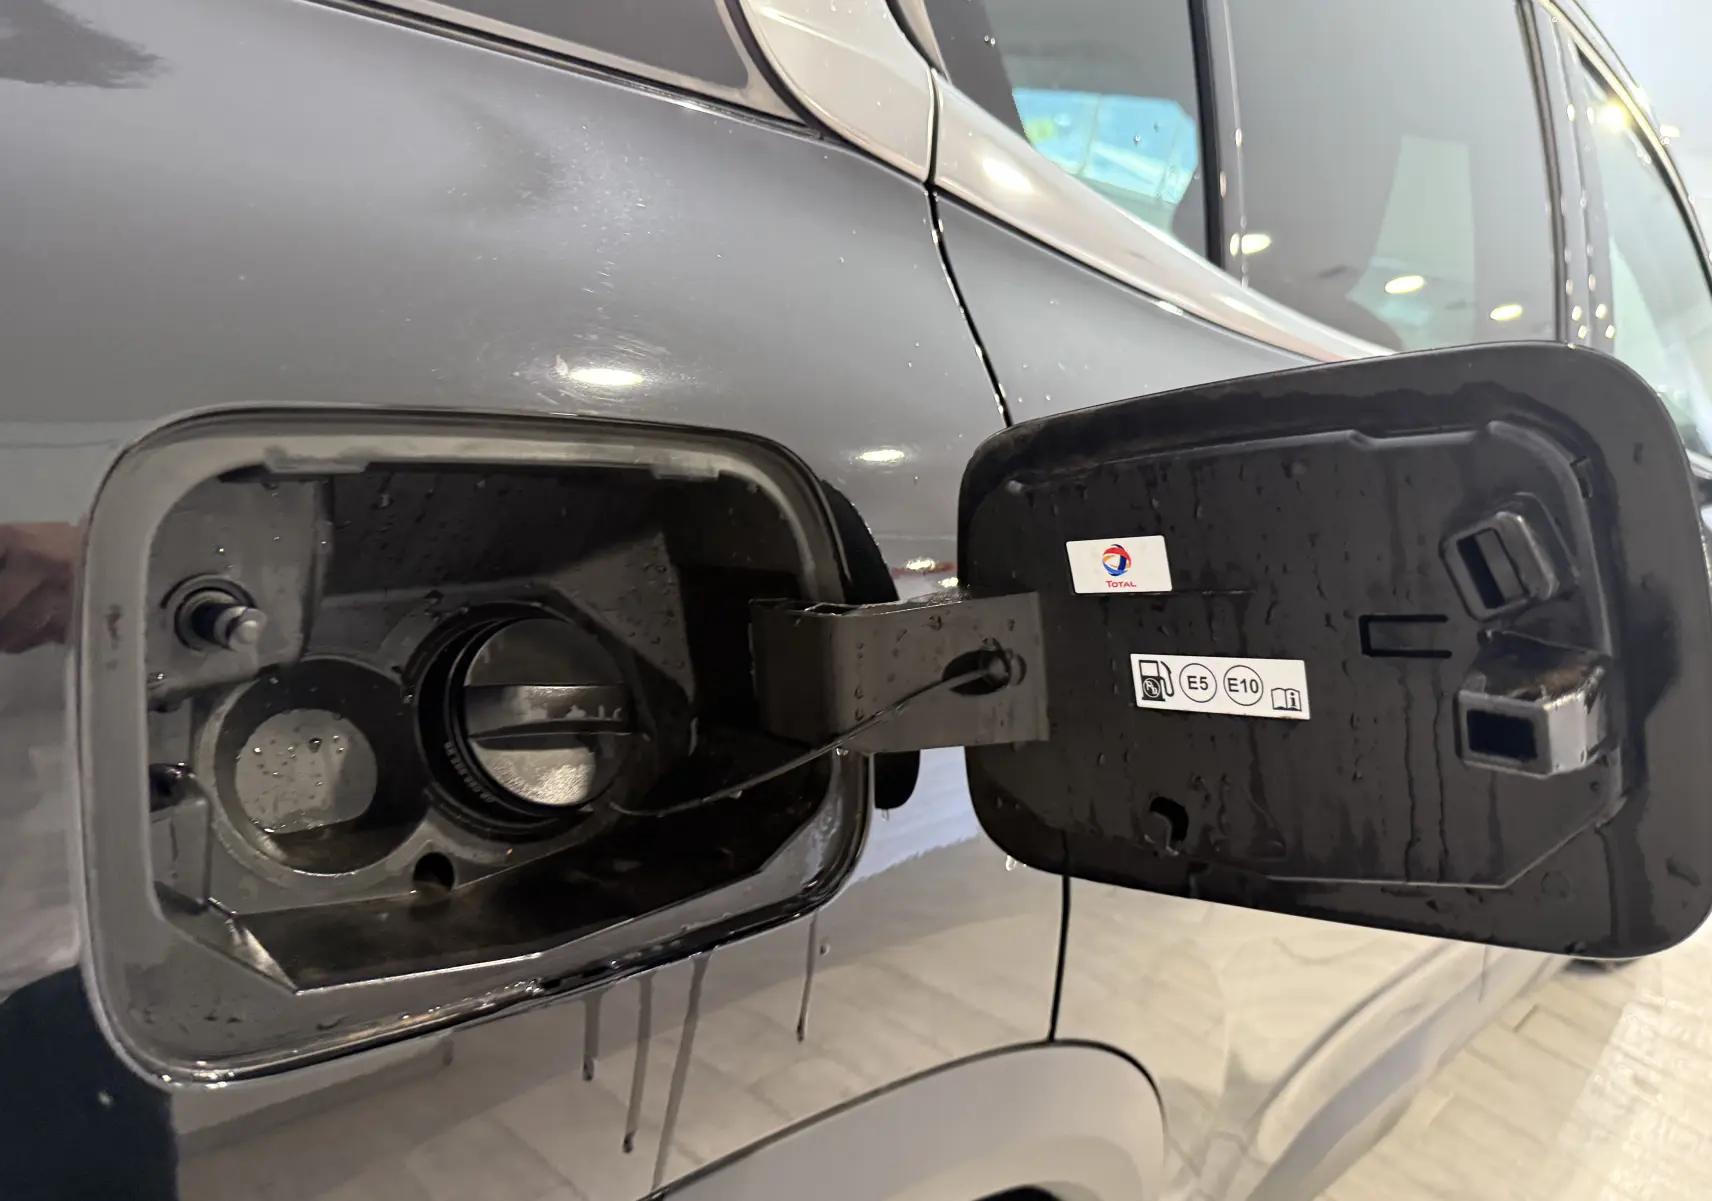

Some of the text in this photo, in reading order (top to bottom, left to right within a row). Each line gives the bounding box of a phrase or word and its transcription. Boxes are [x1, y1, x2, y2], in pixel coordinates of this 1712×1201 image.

[1105, 580, 1137, 588] TOTAL
[1187, 675, 1209, 691] E5
[1227, 677, 1259, 694] E10
